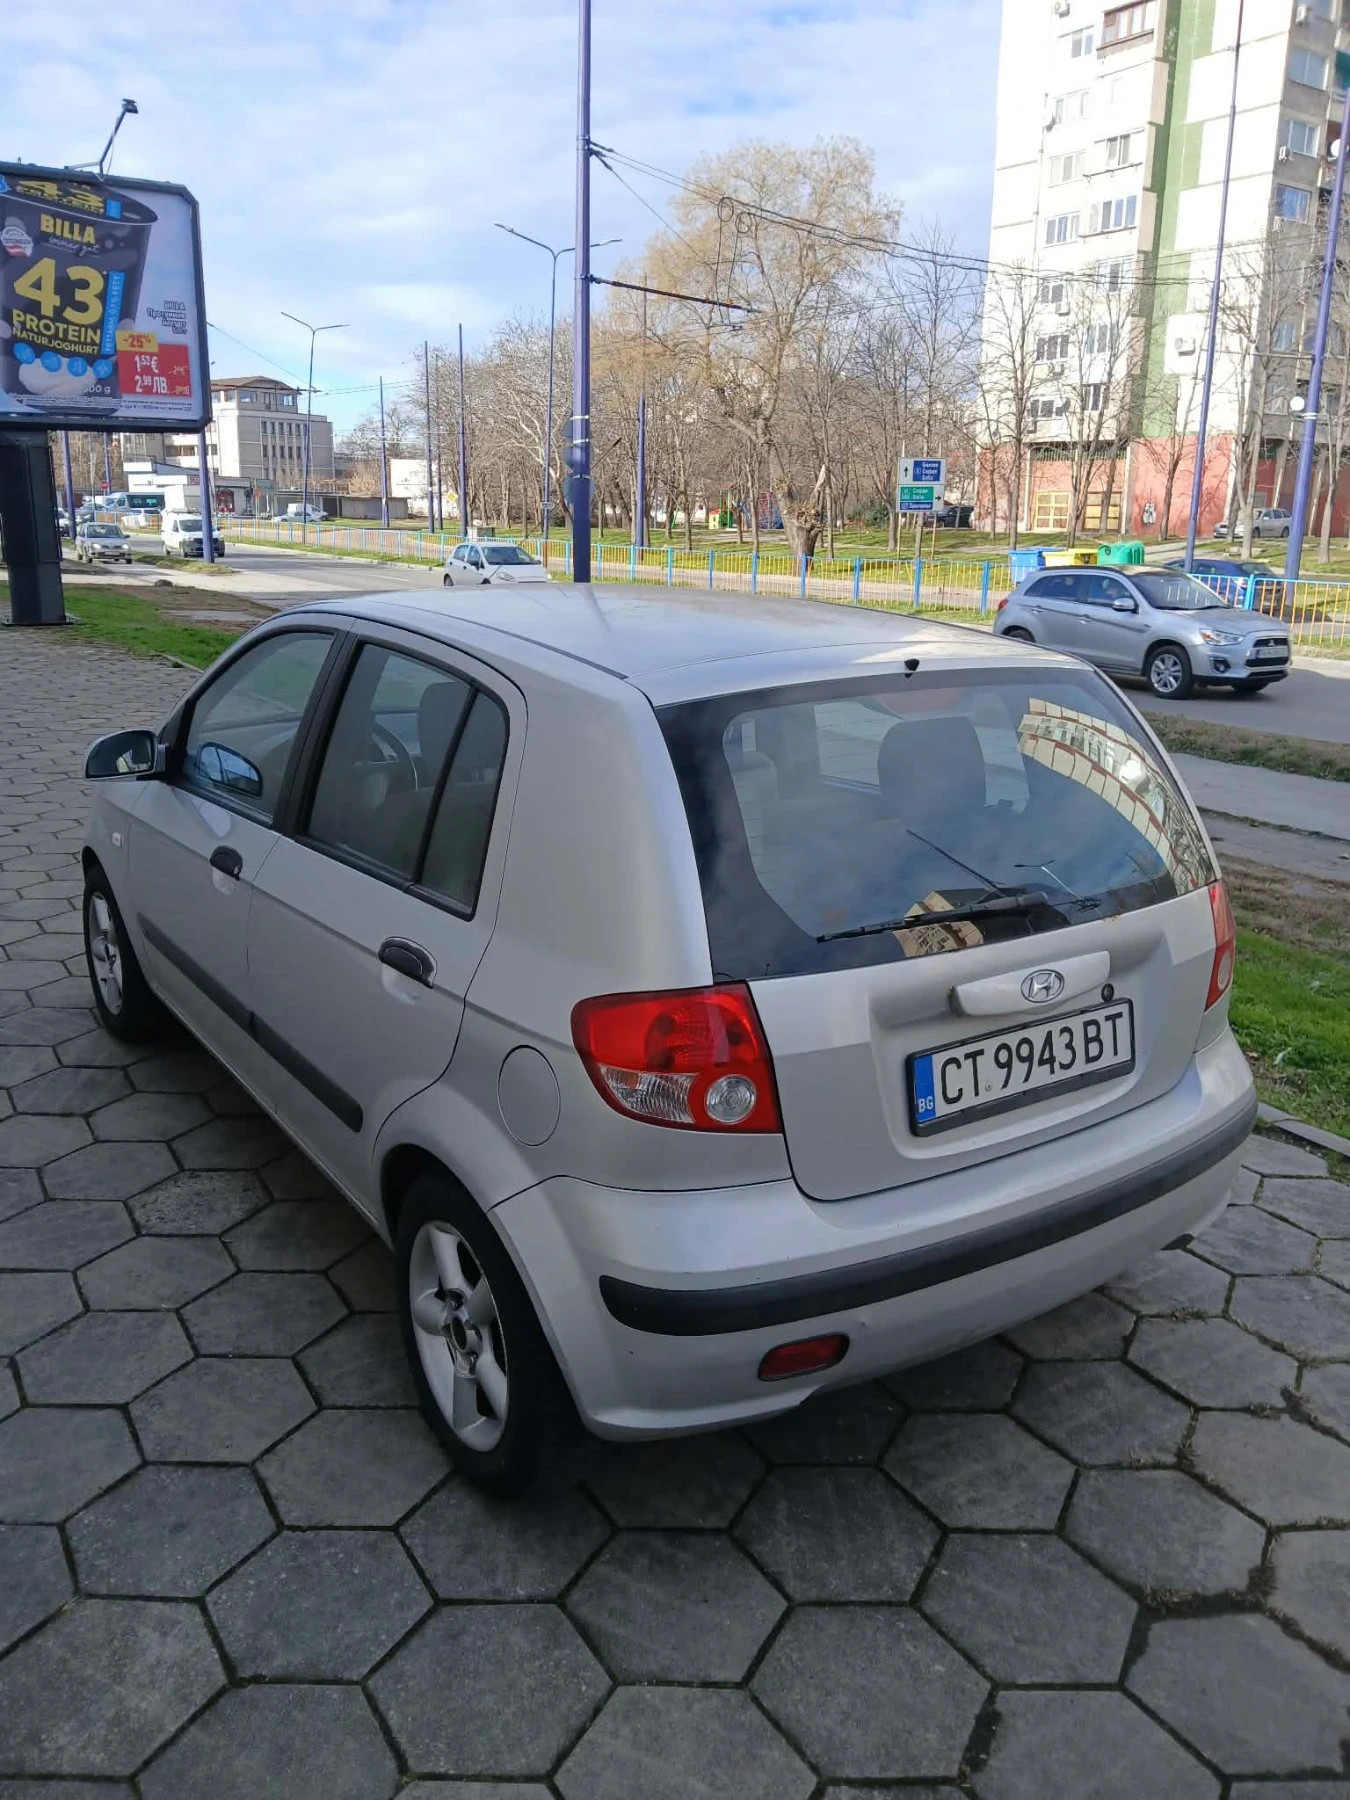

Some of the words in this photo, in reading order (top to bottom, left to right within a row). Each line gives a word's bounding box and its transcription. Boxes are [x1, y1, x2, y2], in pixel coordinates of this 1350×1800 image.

[41, 213, 96, 245] BILLA
[14, 257, 104, 325] 43
[12, 309, 101, 344] PROTEIN
[12, 327, 99, 355] NATURJOGHURT
[123, 334, 151, 349] -25%
[940, 1048, 985, 1105] CT
[993, 1025, 1077, 1090] 9943
[1083, 1011, 1123, 1065] BT
[918, 1095, 934, 1113] BG
